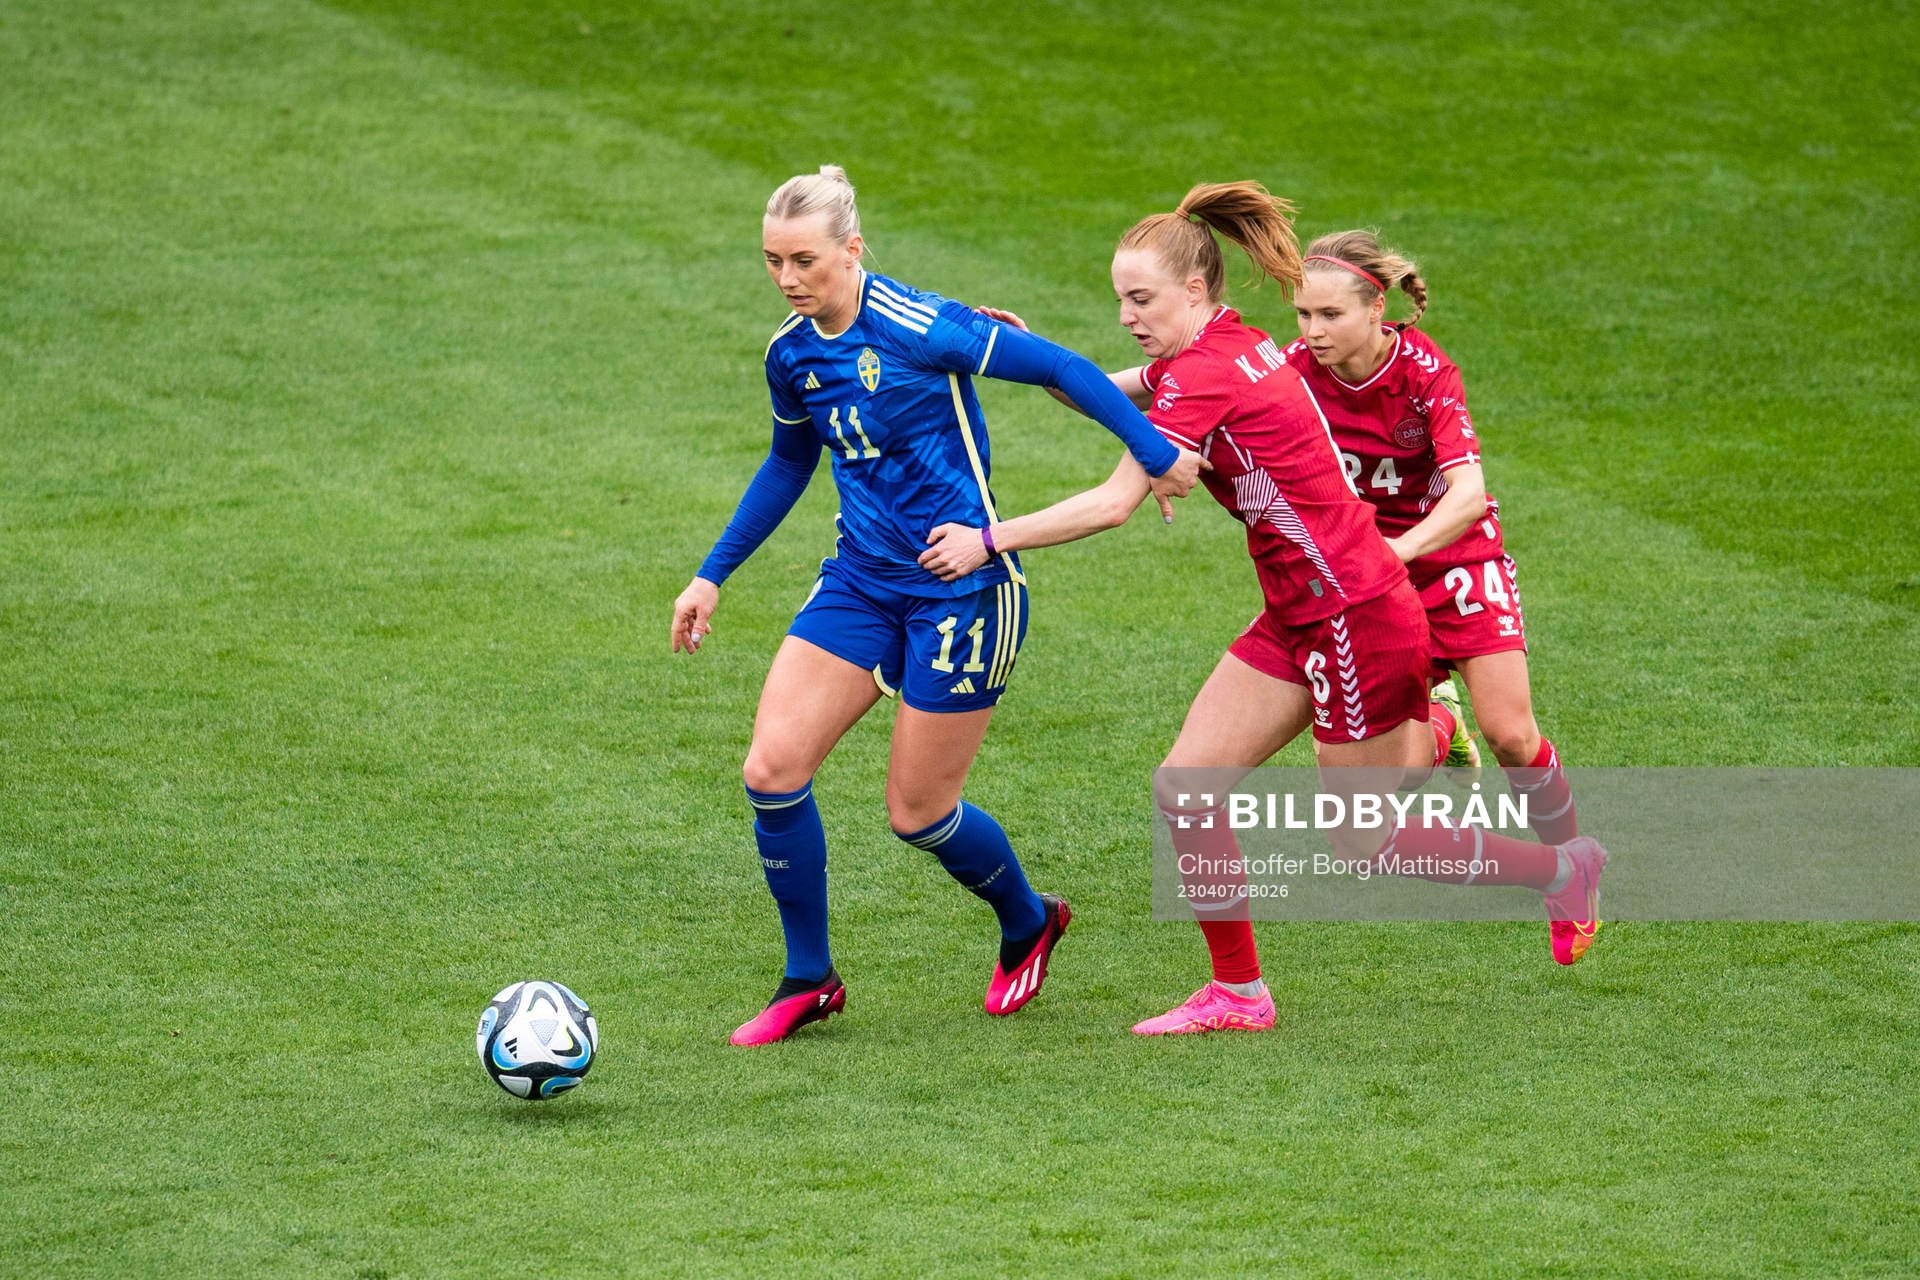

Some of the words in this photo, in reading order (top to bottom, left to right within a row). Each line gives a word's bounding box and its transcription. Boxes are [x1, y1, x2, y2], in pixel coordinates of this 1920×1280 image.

[1234, 353, 1269, 384] K.
[829, 406, 881, 460] 11
[1341, 452, 1404, 496] 24
[1444, 559, 1511, 617] 24
[931, 616, 985, 674] 11
[1304, 651, 1331, 704] 6
